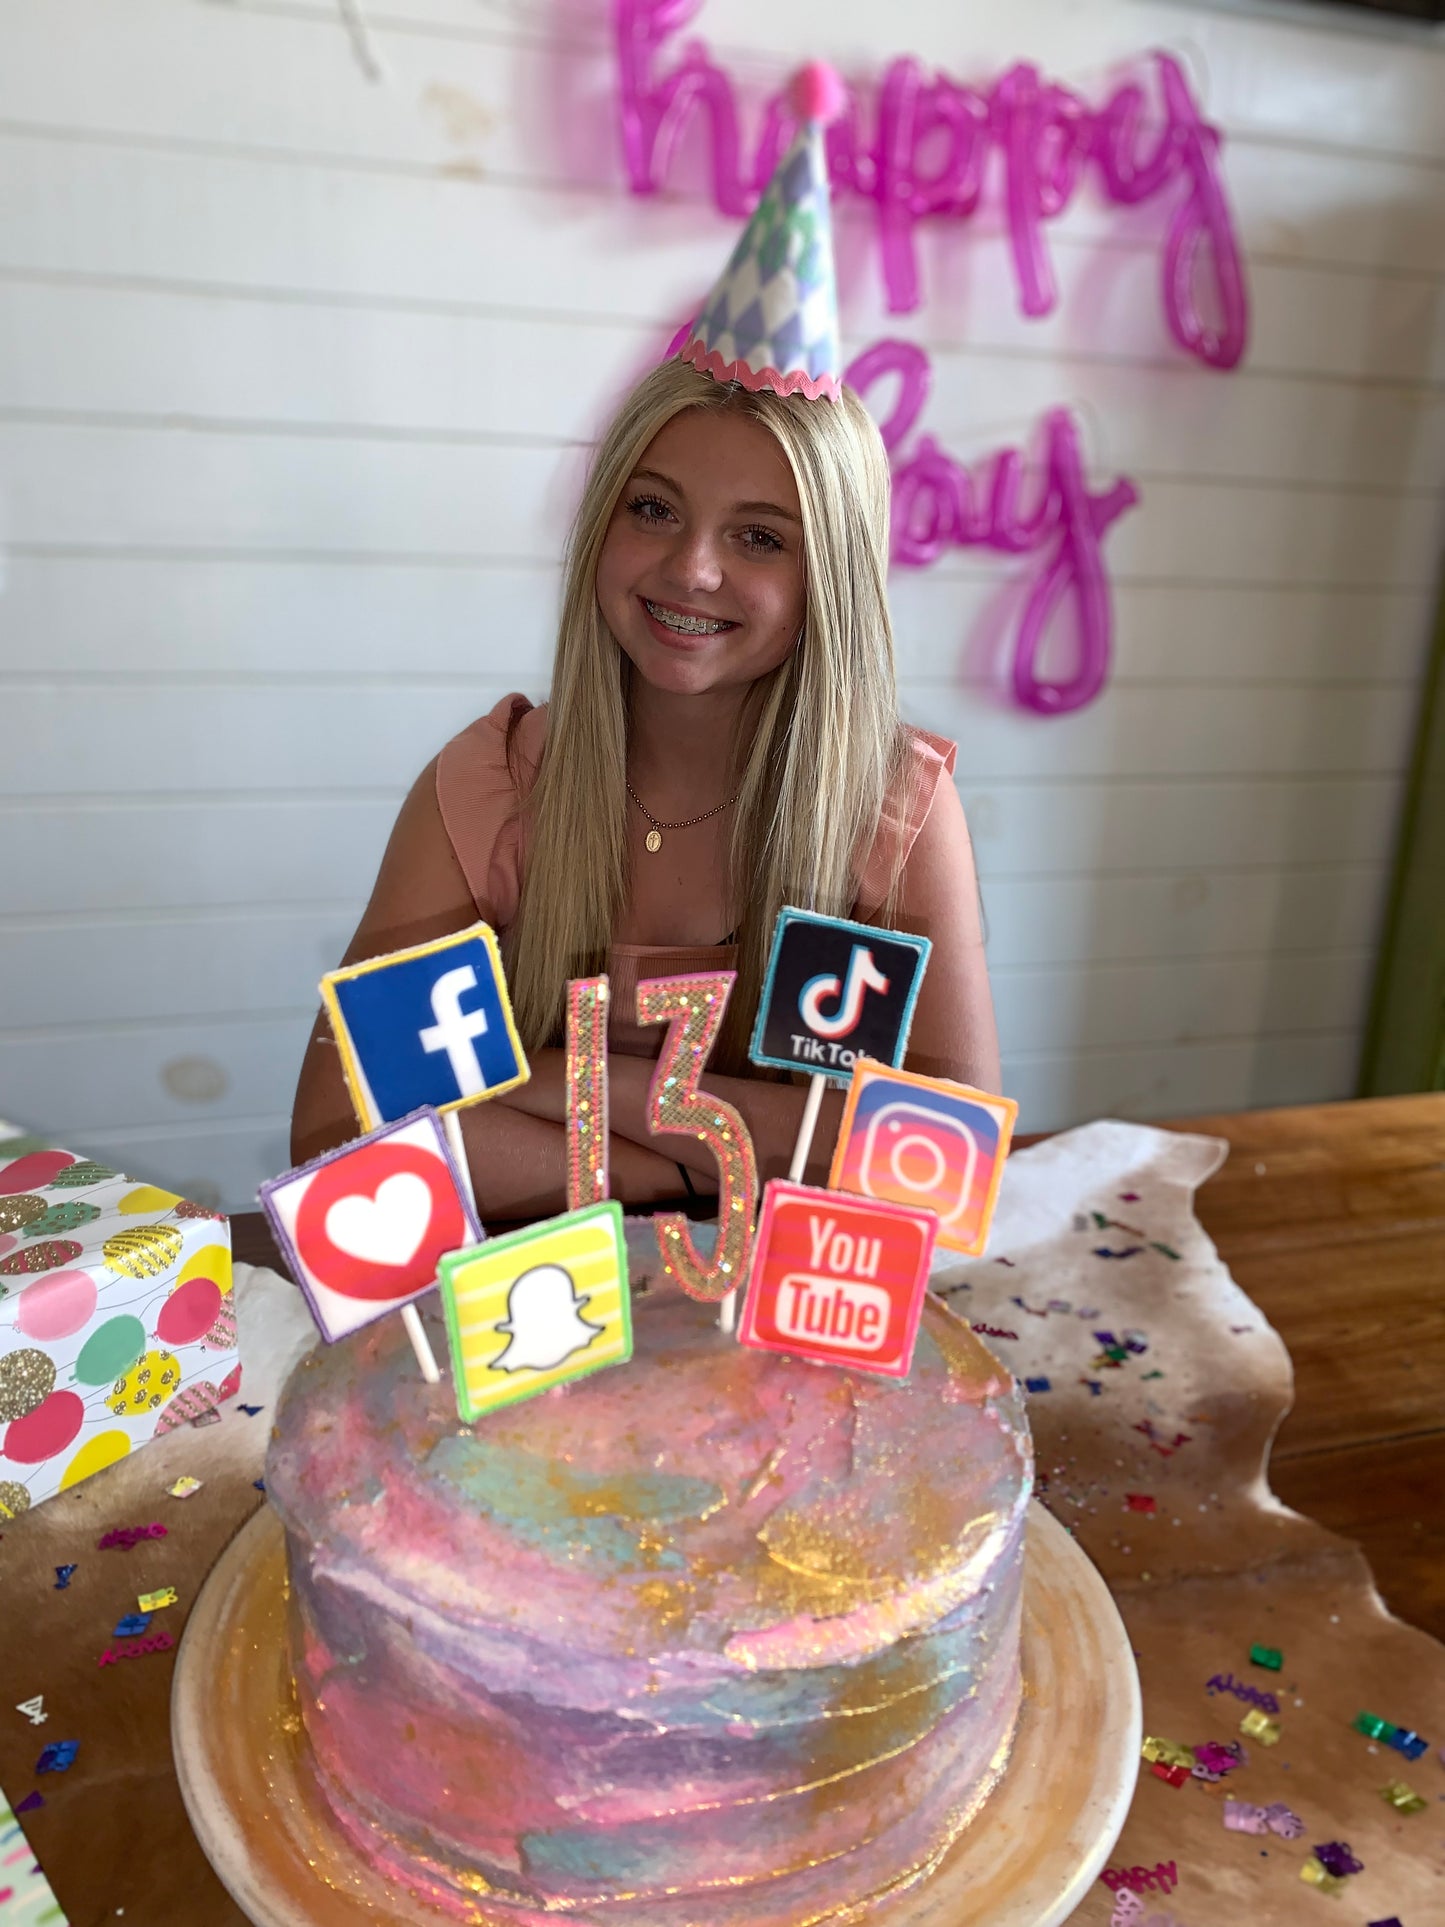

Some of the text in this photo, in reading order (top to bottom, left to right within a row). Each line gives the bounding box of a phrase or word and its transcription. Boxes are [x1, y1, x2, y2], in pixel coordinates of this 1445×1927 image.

[566, 971, 759, 1302] 13
[809, 1215, 882, 1279] You
[788, 1280, 881, 1344] Tube
